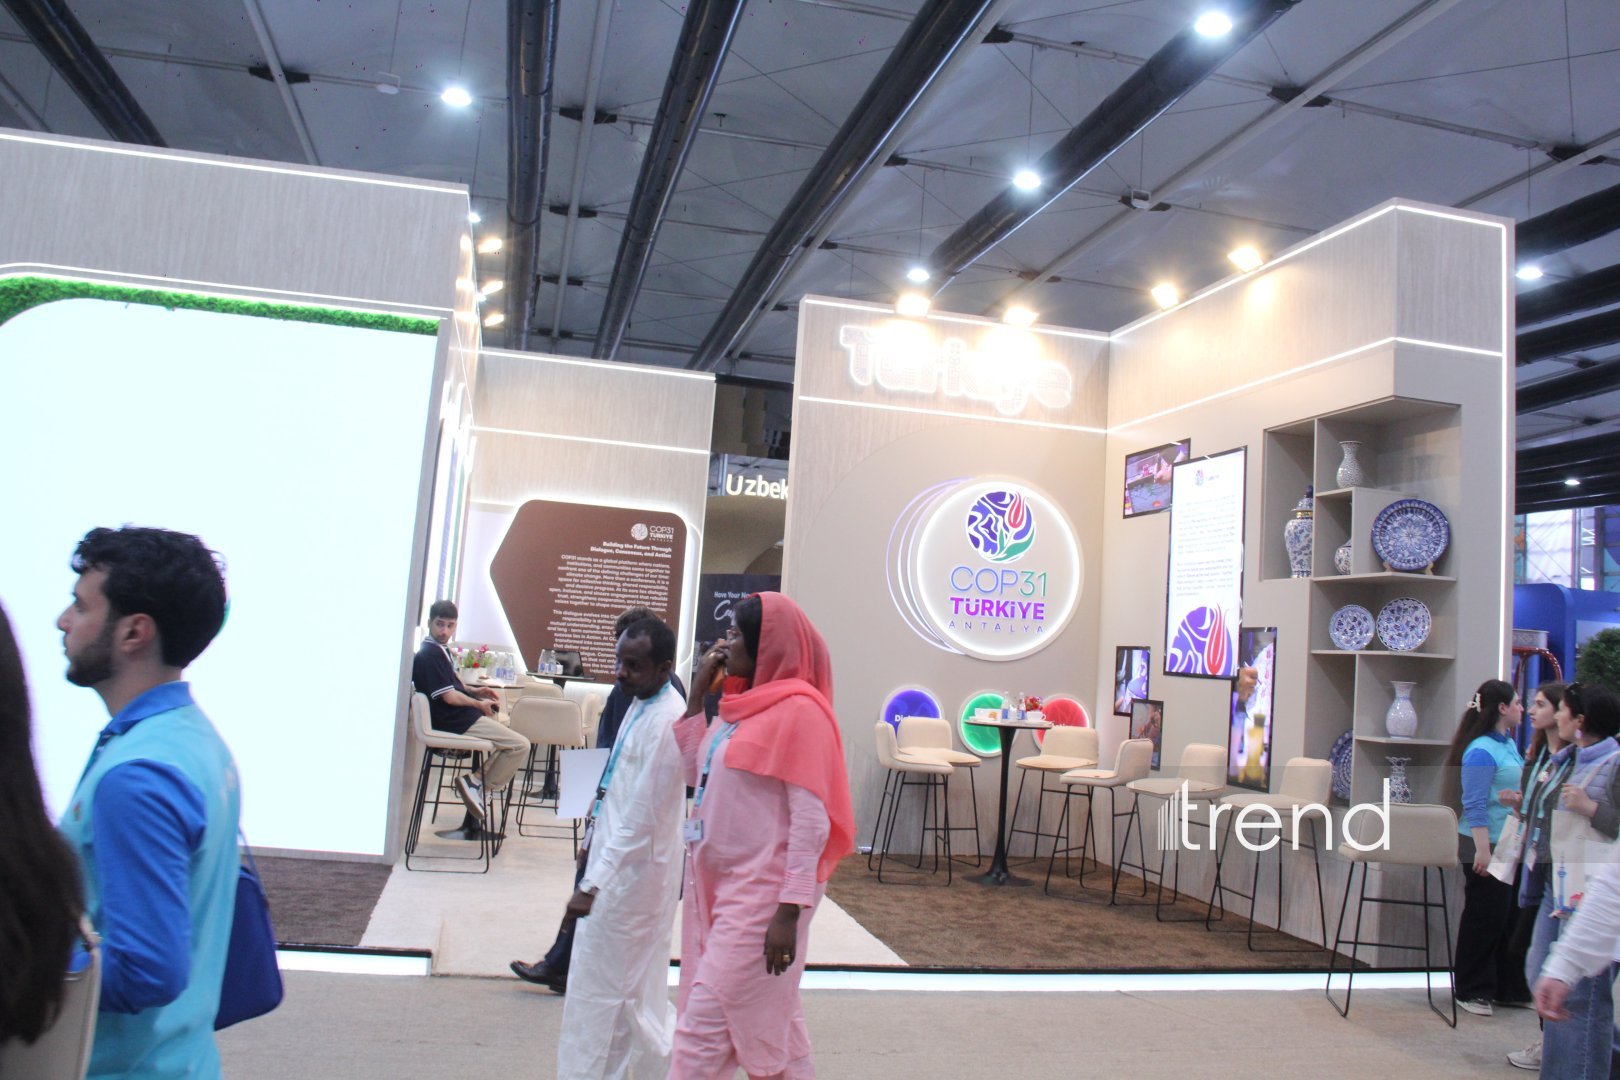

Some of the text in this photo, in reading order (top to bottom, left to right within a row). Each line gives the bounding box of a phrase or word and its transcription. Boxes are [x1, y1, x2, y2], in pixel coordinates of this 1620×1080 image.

[726, 474, 789, 500] Uzbek
[650, 525, 674, 534] COP31
[590, 546, 614, 554] Dialogue,
[650, 545, 672, 553] Through
[951, 566, 1047, 597] COP31
[948, 620, 1044, 633] ANTALYA
